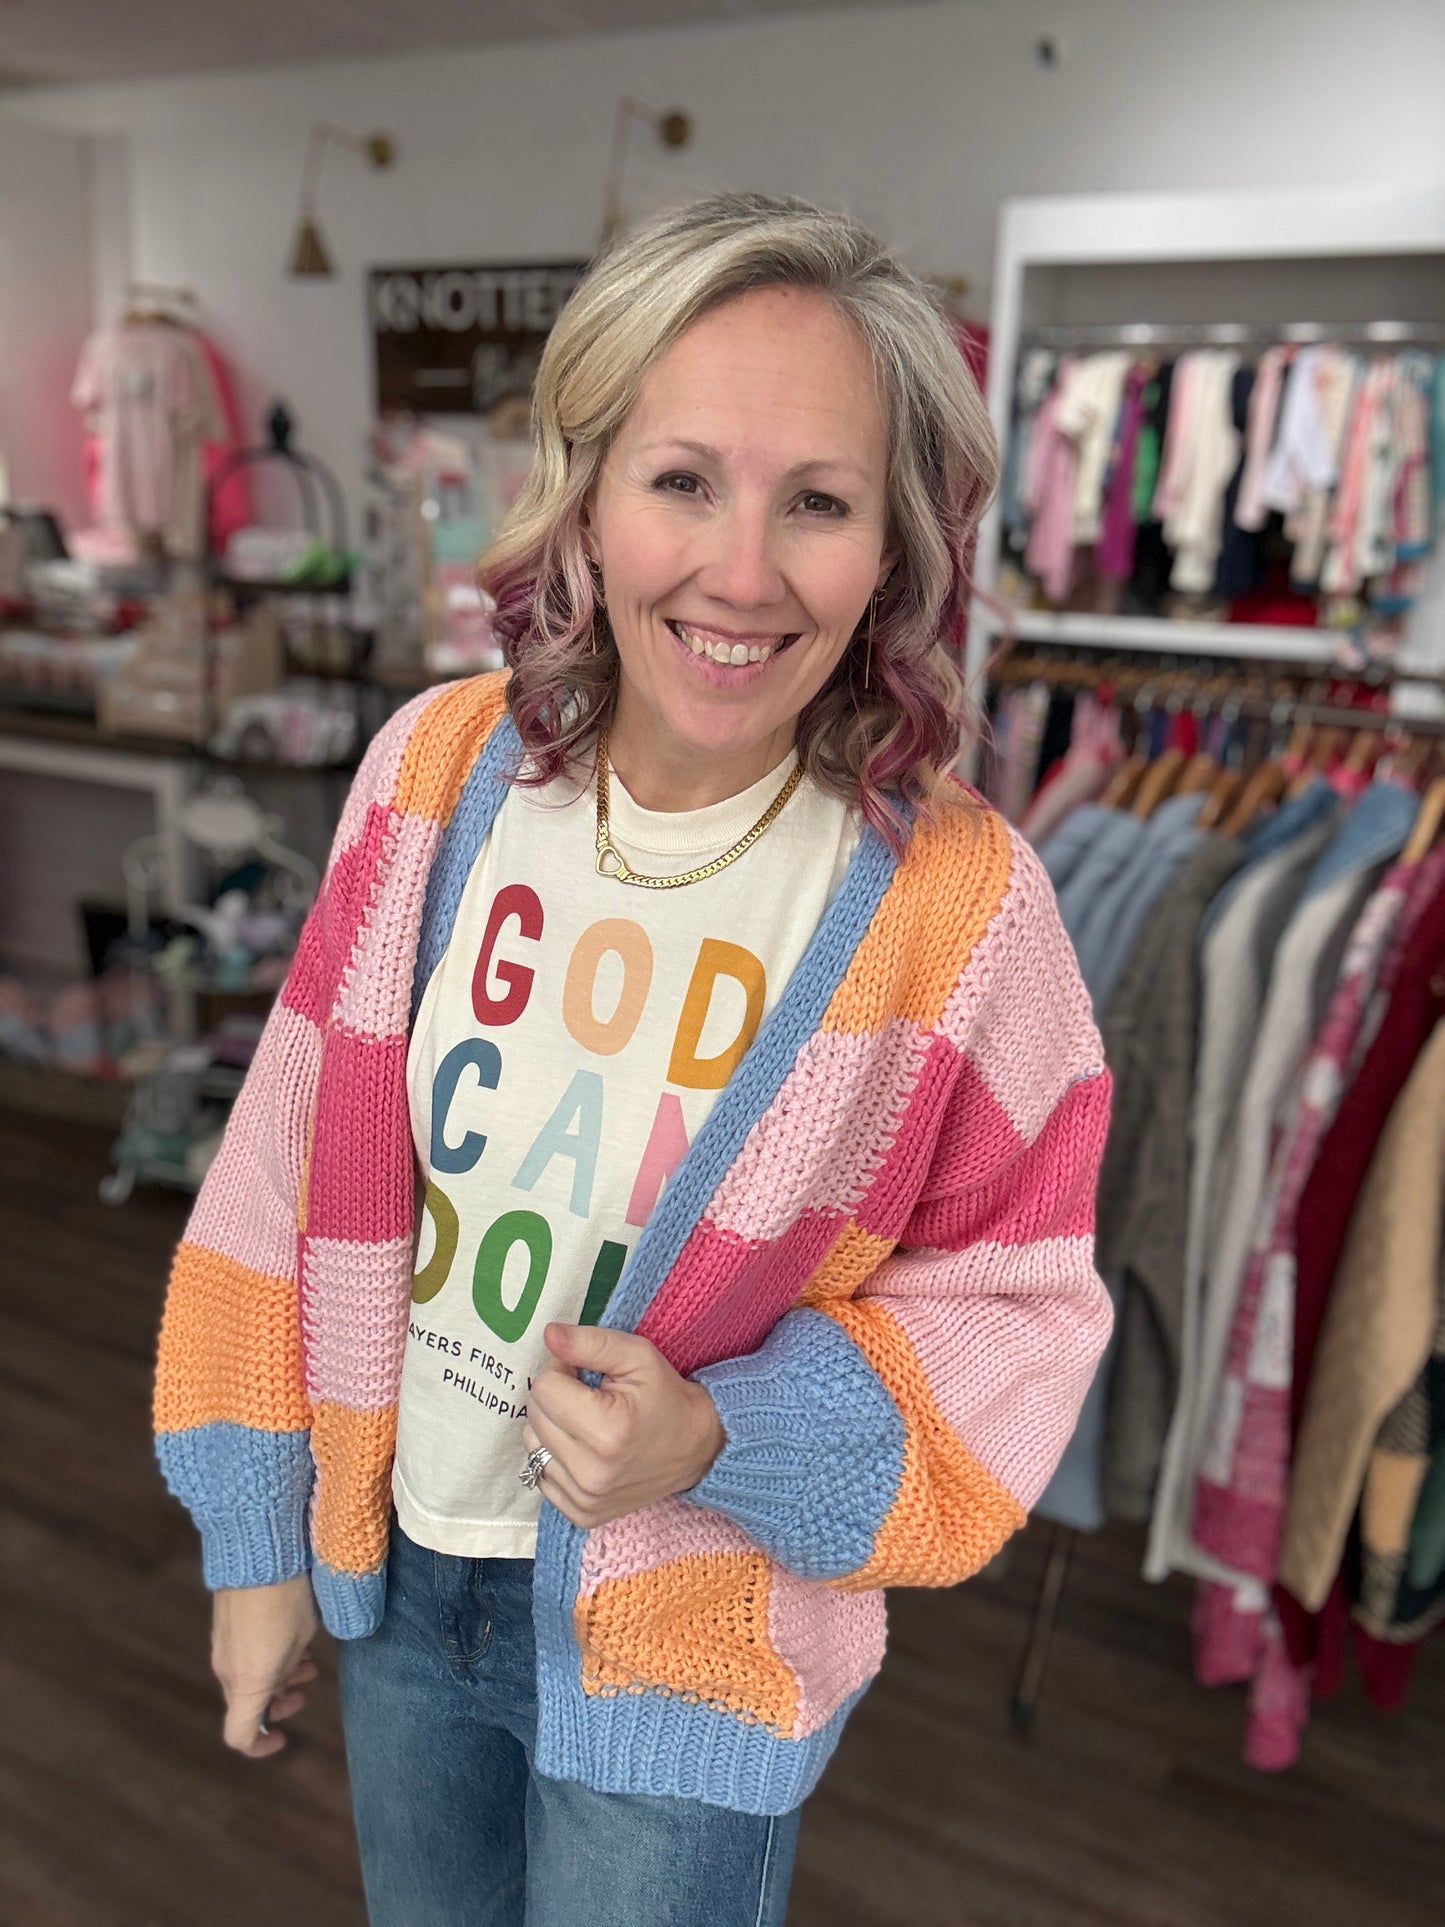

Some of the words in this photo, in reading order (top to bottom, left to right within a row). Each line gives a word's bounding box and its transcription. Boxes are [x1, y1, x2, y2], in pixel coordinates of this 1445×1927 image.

[471, 883, 767, 1090] GOD
[408, 1321, 463, 1357] AYERS
[469, 1347, 515, 1391] FIRST,
[442, 1368, 528, 1419] PHILLIPPIA
